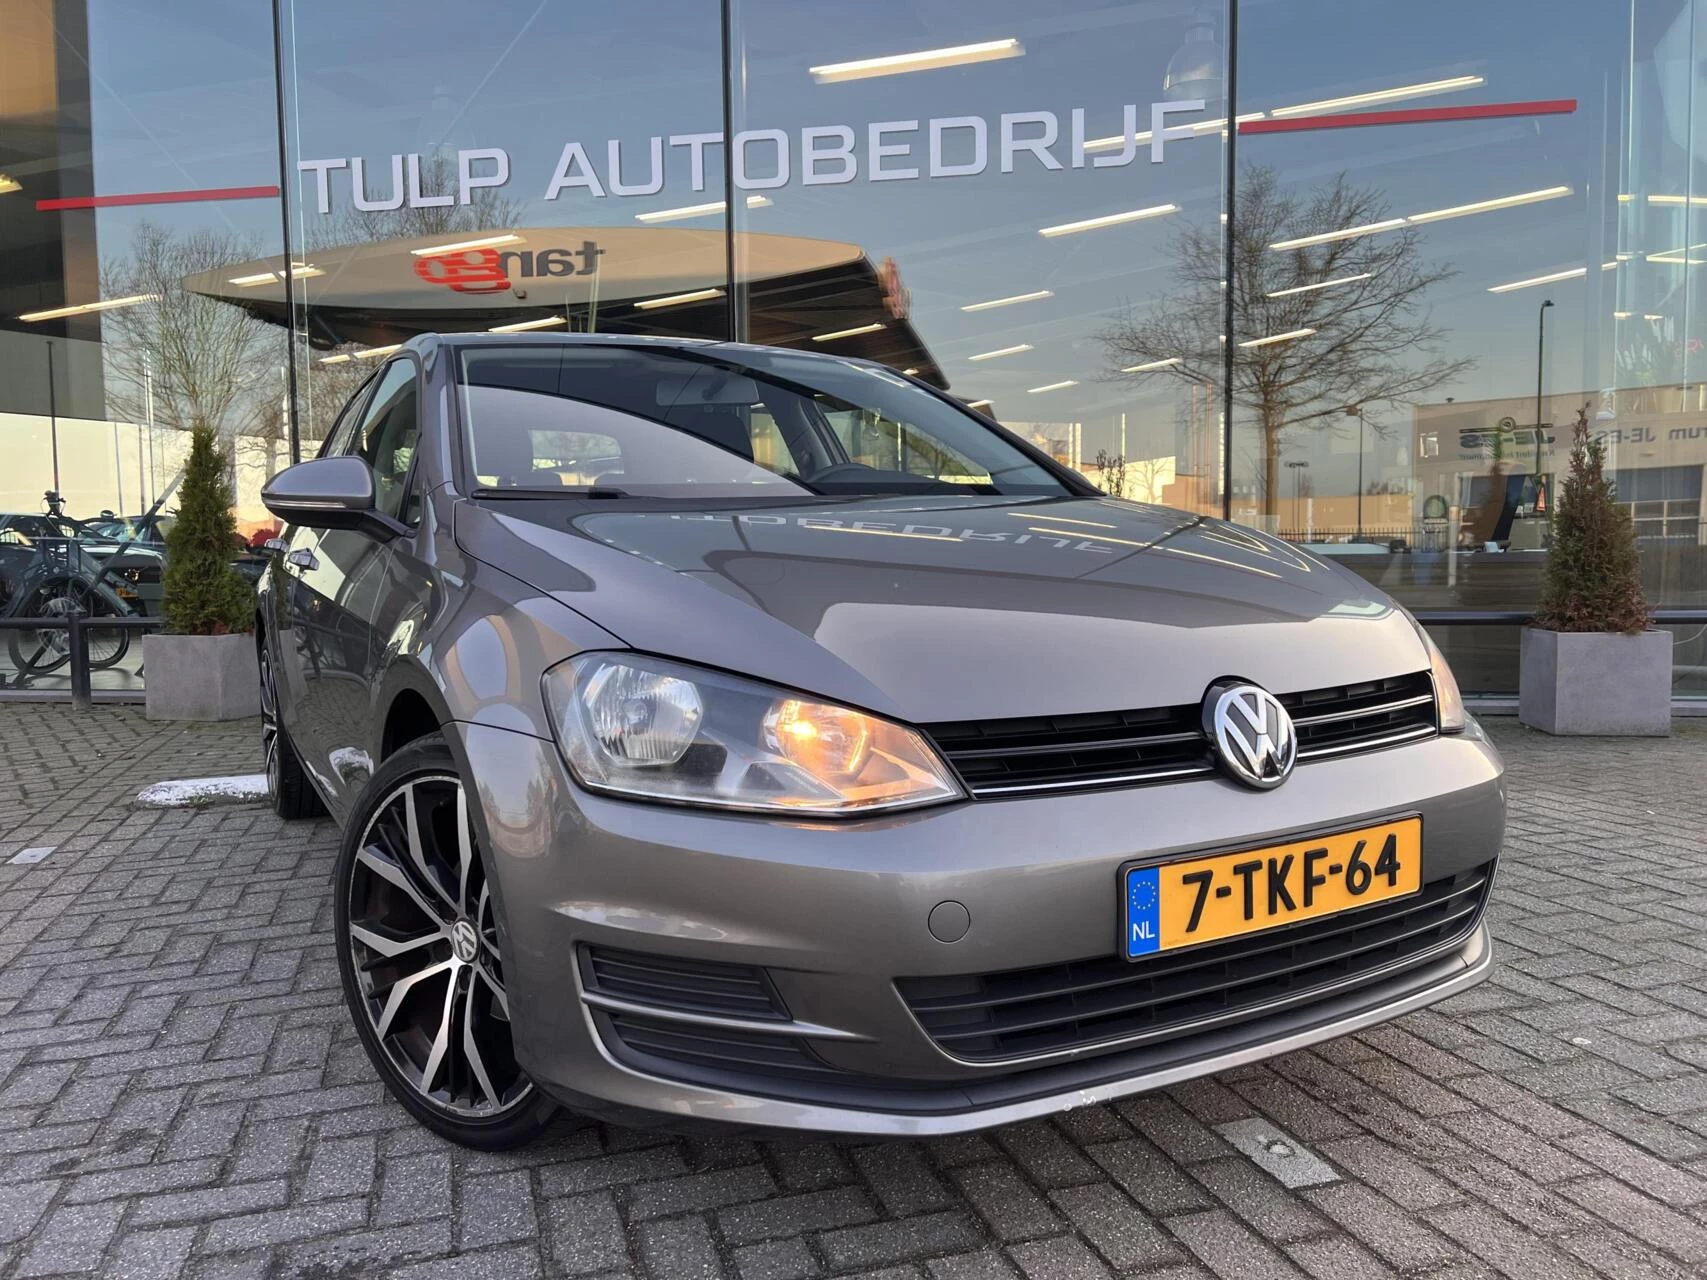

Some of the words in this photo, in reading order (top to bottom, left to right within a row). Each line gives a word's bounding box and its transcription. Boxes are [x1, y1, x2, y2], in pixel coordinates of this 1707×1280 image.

[297, 147, 511, 214] TULP
[544, 100, 1207, 201] AUTOBEDRIJF
[1132, 920, 1156, 941] NL
[1182, 833, 1401, 932] 7-TKF-64
